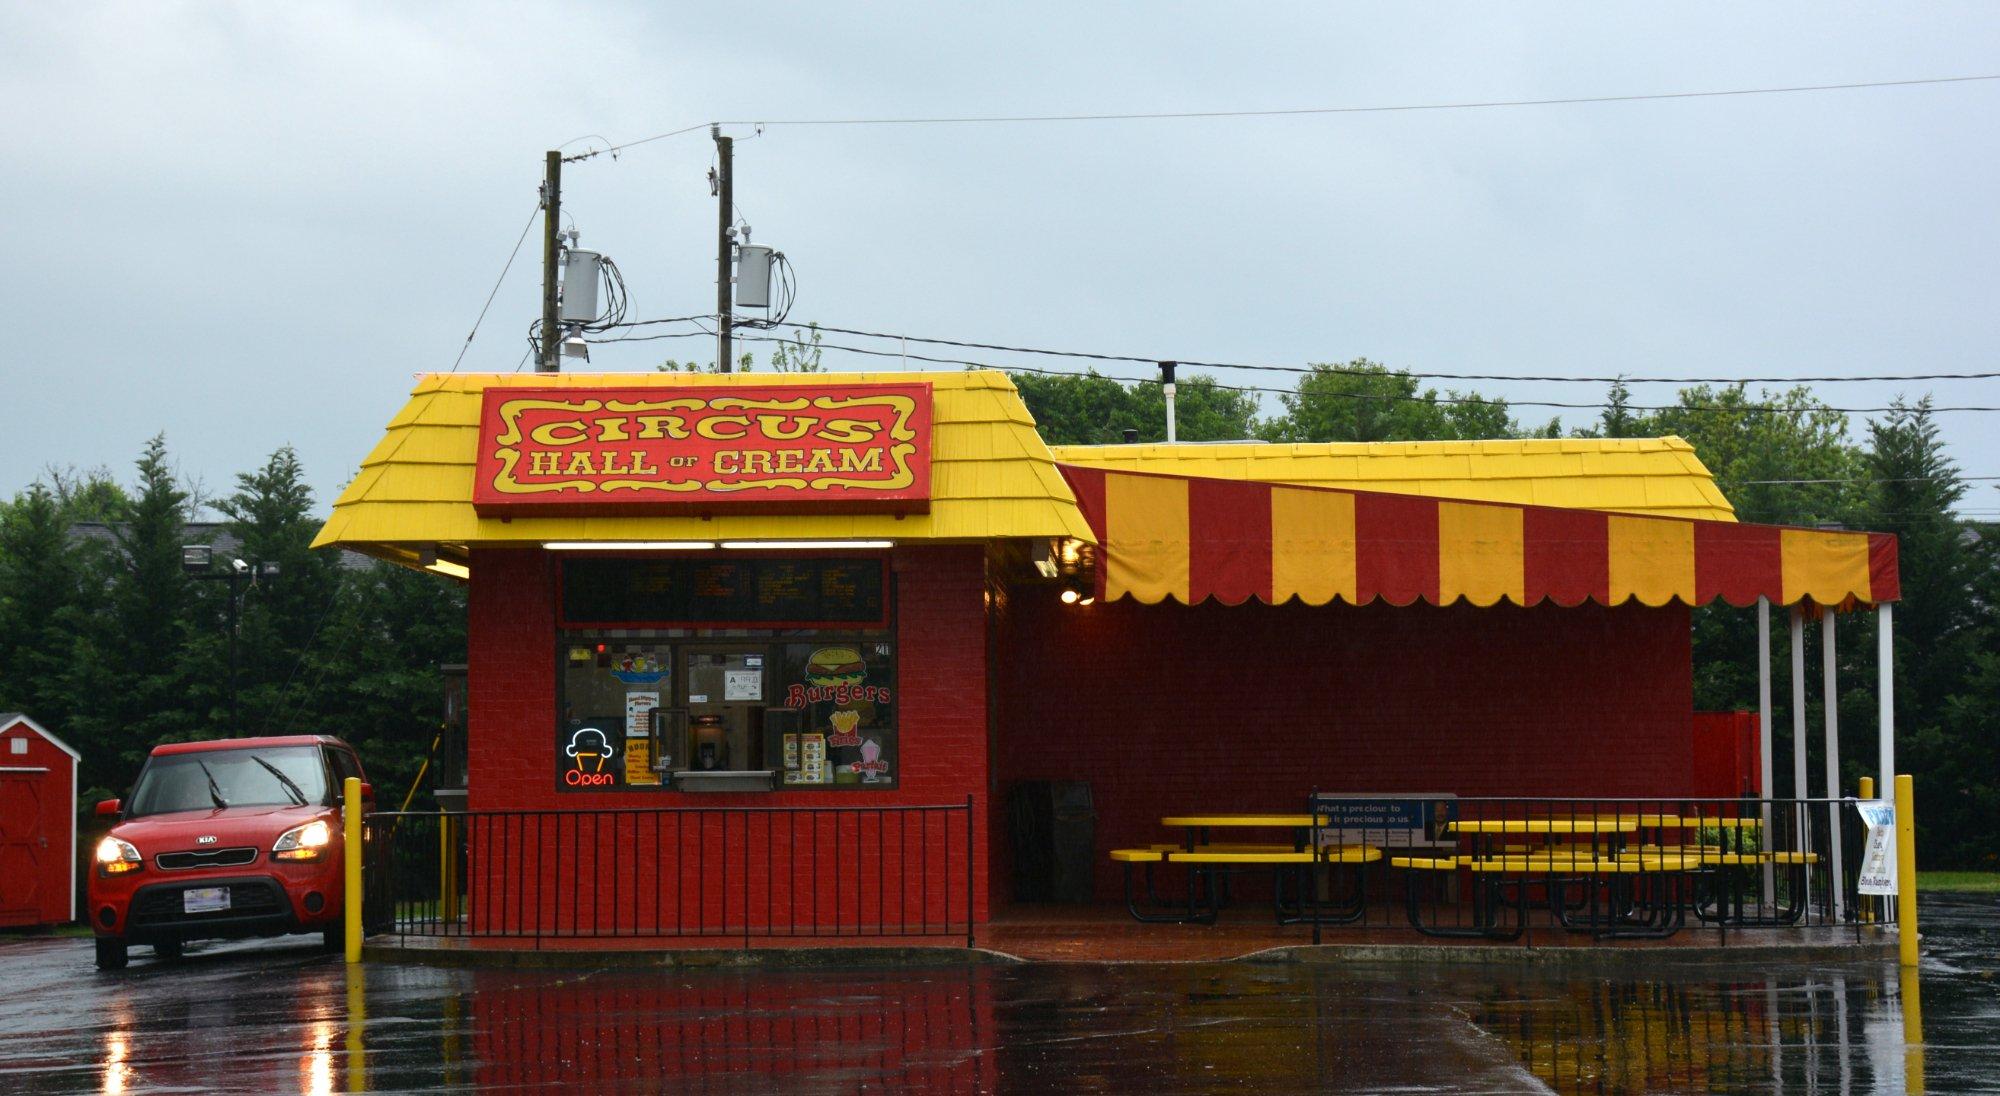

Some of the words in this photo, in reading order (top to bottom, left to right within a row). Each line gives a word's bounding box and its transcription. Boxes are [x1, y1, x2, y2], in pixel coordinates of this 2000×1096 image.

[530, 414, 884, 446] CIRCUS
[527, 450, 657, 476] HALL
[668, 455, 698, 468] OF
[713, 447, 885, 475] CREAM
[784, 681, 891, 710] Burgers
[565, 769, 613, 786] Open
[1391, 804, 1400, 813] to
[1344, 815, 1383, 825] precious
[198, 836, 215, 844] KIA
